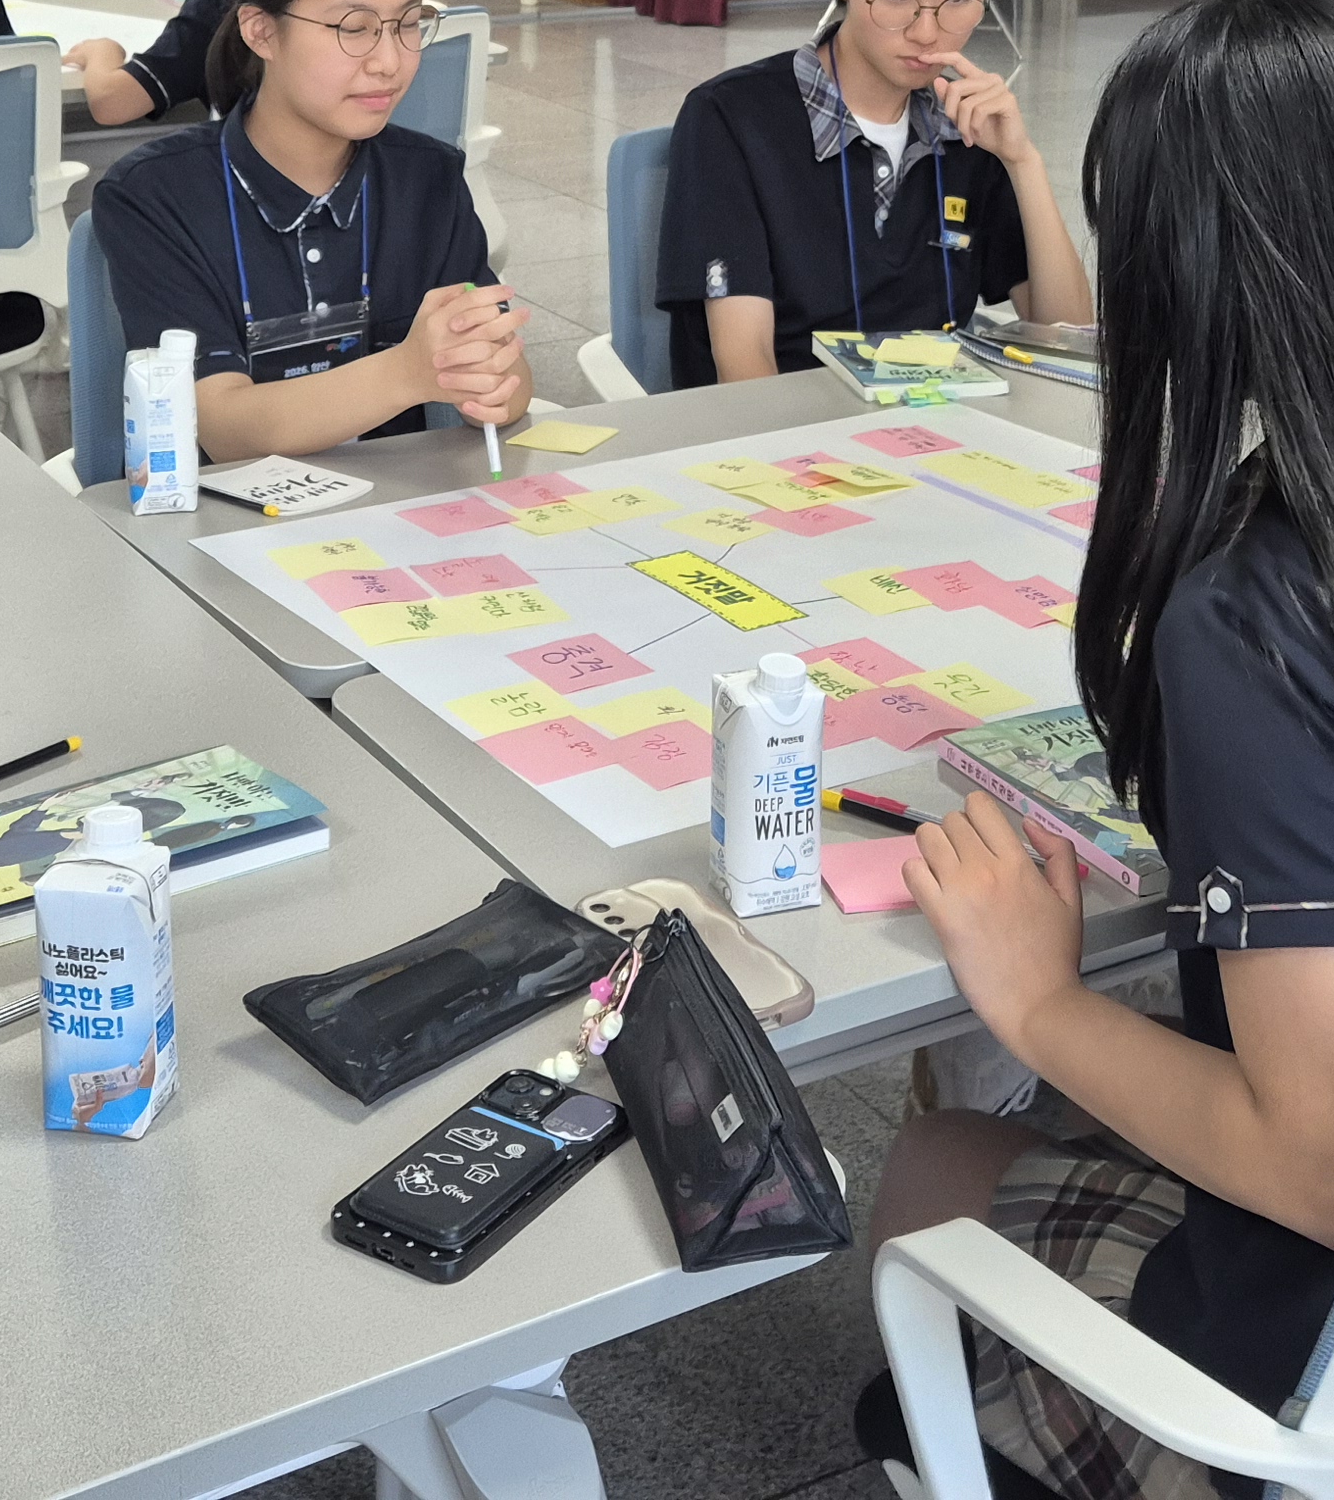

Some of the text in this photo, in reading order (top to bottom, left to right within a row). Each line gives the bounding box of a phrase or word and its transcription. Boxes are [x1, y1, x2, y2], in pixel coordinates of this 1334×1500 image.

[678, 570, 756, 606] 거짓말
[541, 644, 613, 680] 충격
[490, 691, 547, 718] 놀람
[1033, 729, 1096, 752] 거짓
[777, 754, 797, 765] JUST
[753, 764, 818, 807] 기픈 물
[754, 796, 784, 813] DEEP
[754, 807, 815, 840] WATER
[41, 940, 125, 963] 나노플라스틱
[55, 962, 108, 980] 싫어요~
[109, 983, 135, 1011] 물
[47, 1008, 124, 1040] 주세요!
